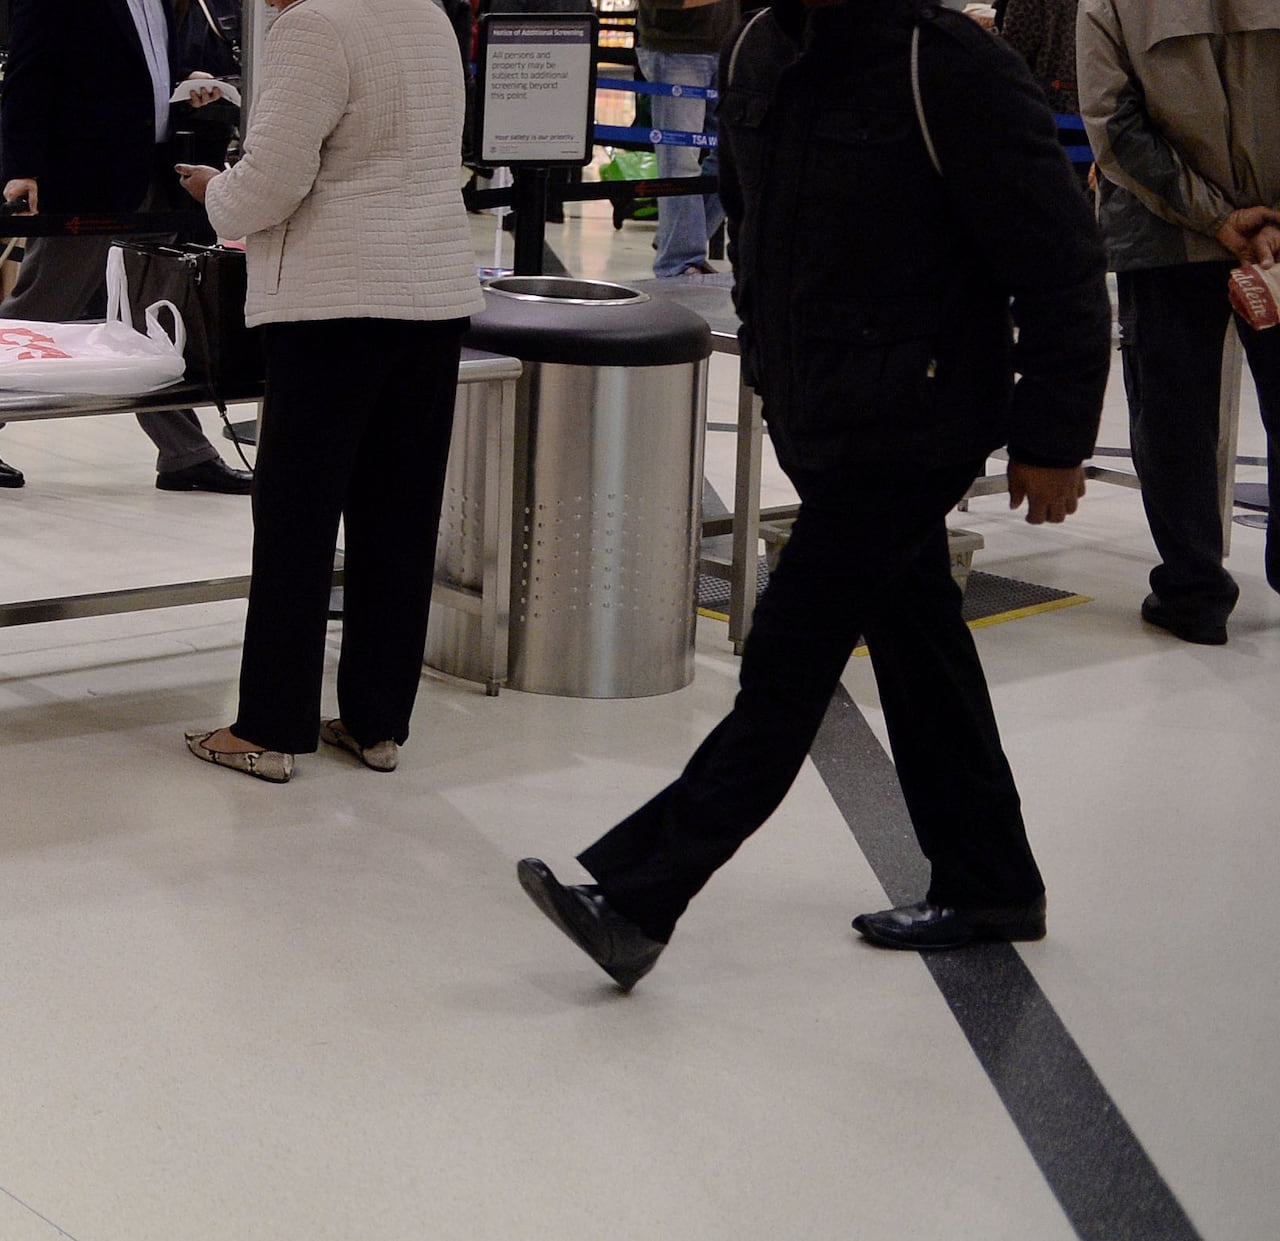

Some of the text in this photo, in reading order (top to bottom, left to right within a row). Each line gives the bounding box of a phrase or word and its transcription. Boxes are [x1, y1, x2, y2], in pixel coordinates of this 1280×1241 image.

[492, 51, 551, 60] All persons and
[491, 62, 525, 70] property
[491, 72, 519, 80] subject
[530, 71, 568, 79] additional
[491, 81, 558, 90] screening beyond
[692, 135, 707, 146] TSA
